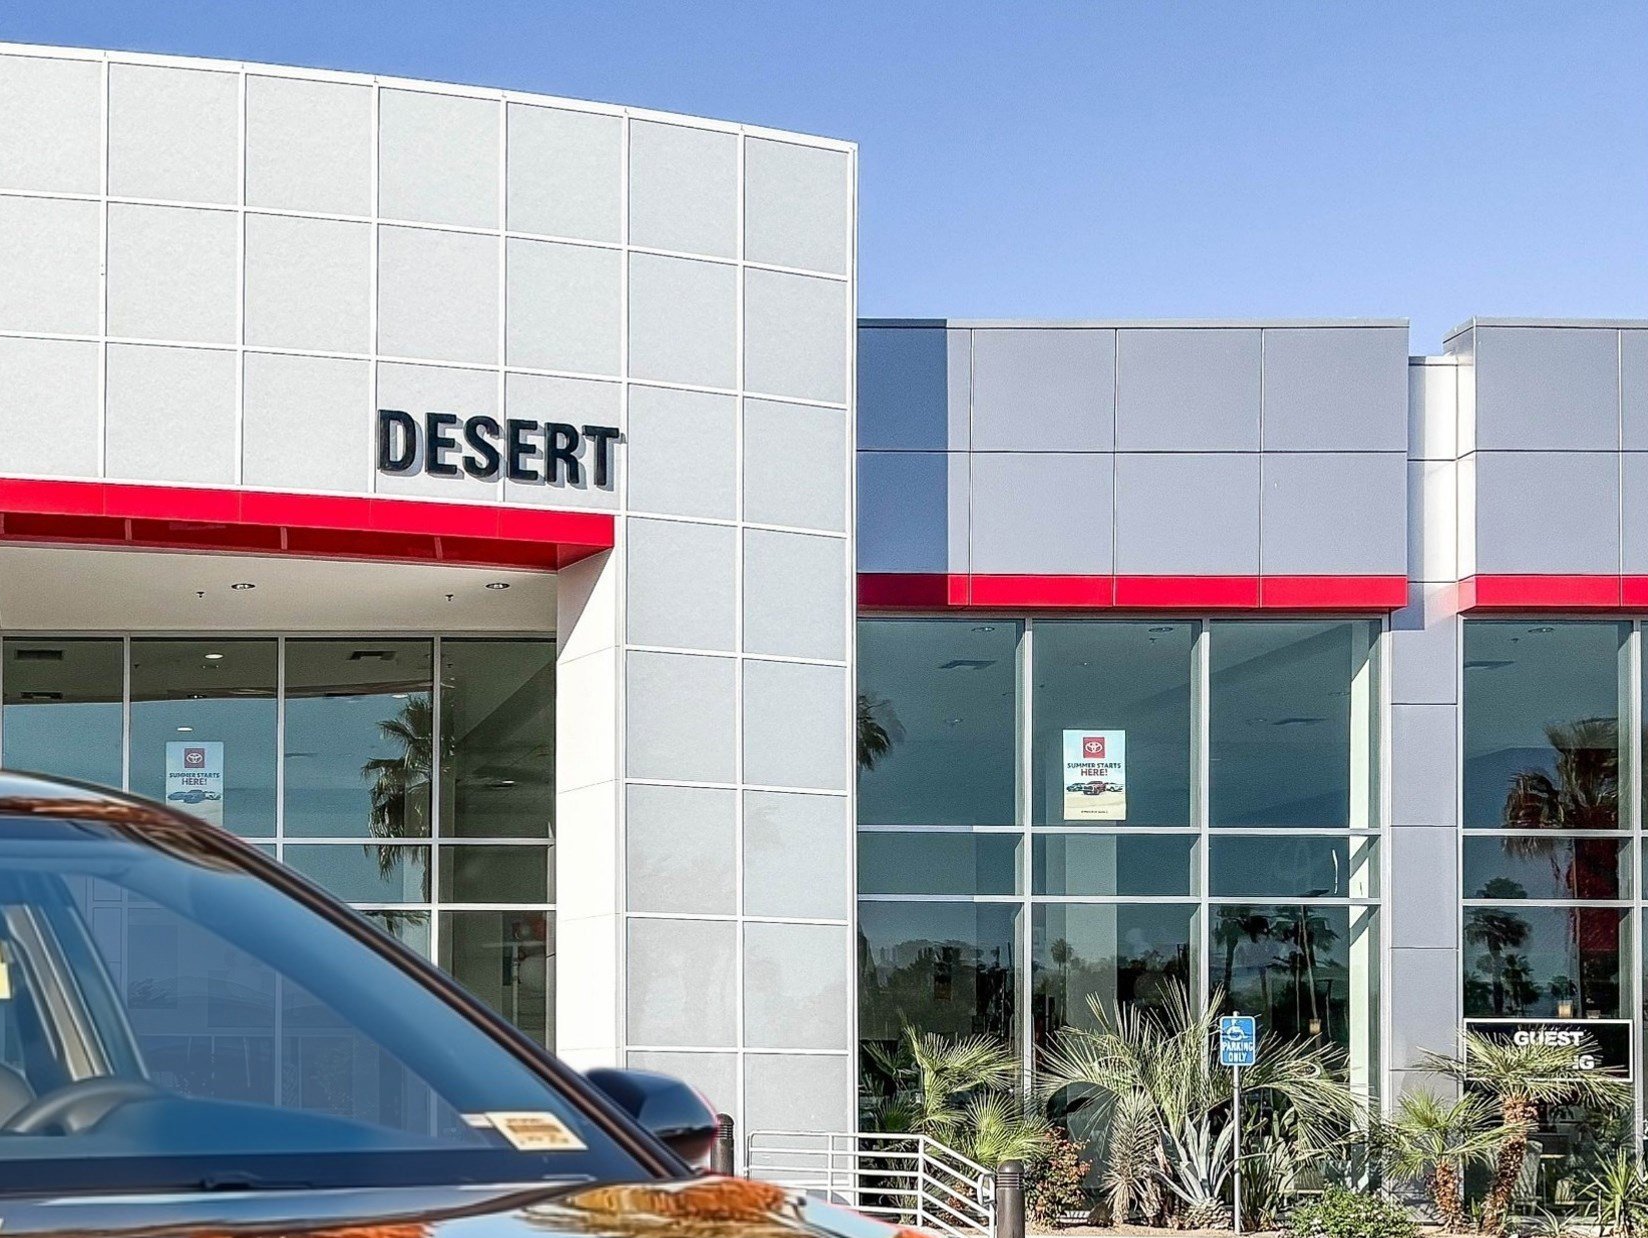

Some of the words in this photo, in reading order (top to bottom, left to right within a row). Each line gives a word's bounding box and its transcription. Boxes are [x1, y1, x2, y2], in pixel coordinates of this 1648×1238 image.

[377, 409, 620, 486] DESERT
[1514, 1031, 1584, 1047] GUEST
[1222, 1041, 1253, 1051] PARKING
[1228, 1051, 1247, 1062] ONLY
